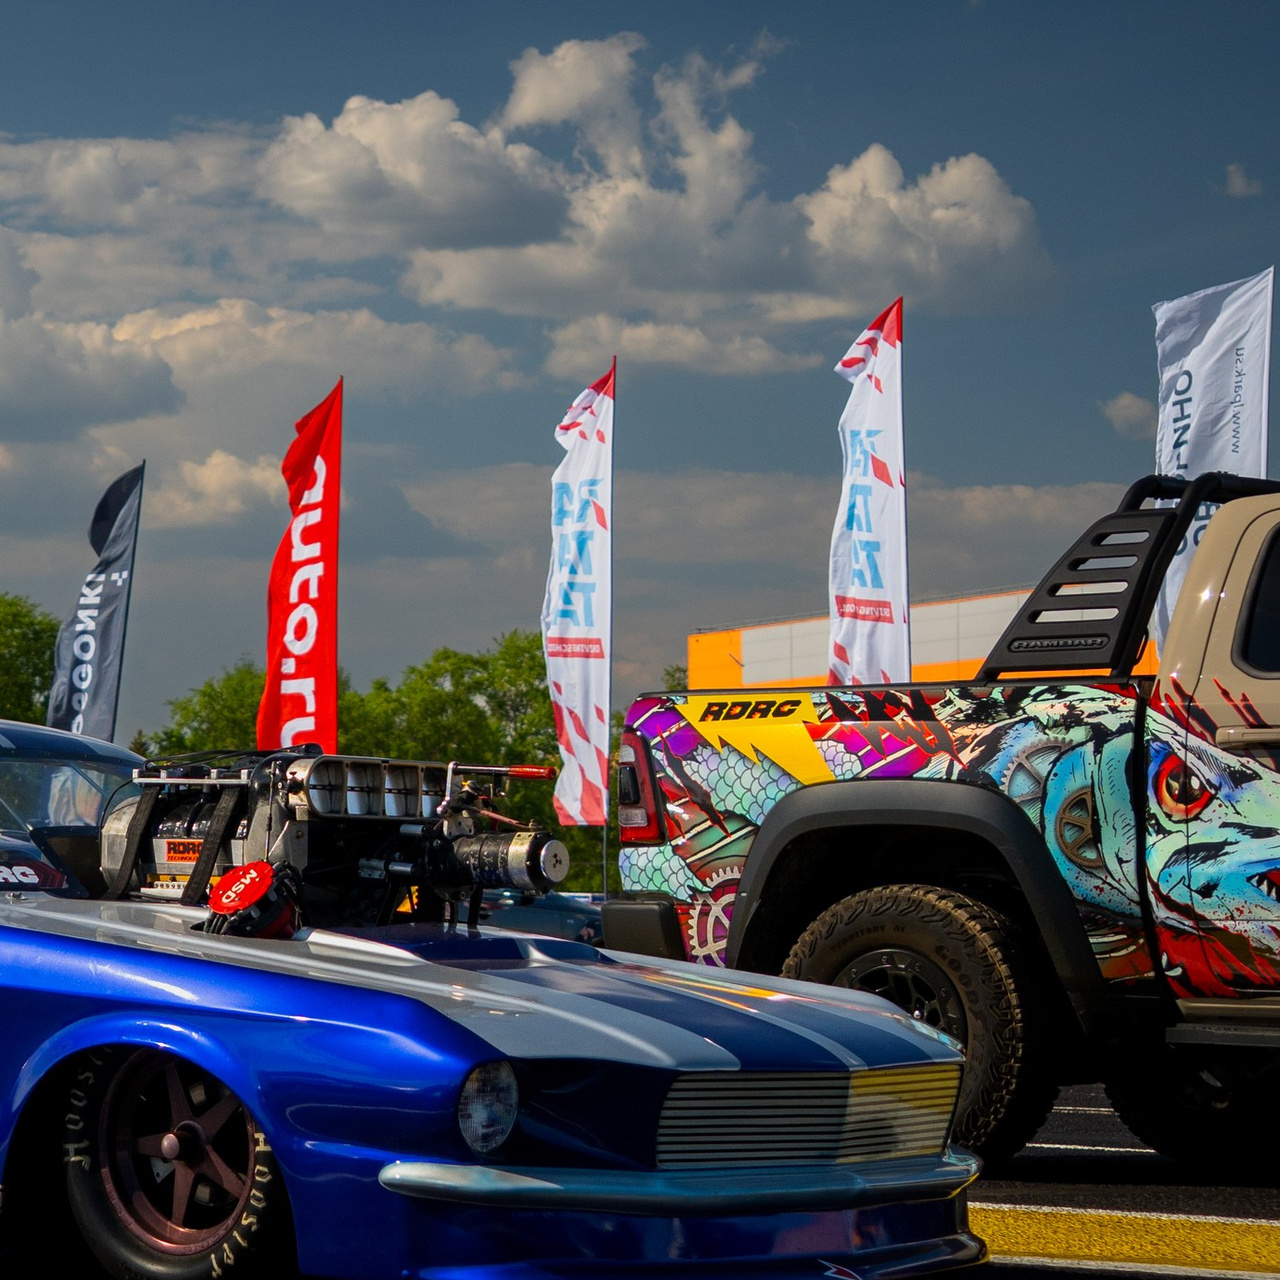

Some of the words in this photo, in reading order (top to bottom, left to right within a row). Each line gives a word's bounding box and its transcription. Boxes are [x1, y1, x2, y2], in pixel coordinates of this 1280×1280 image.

[280, 454, 327, 749] auto.ru
[699, 699, 803, 723] RDRC
[221, 869, 258, 904] MSD
